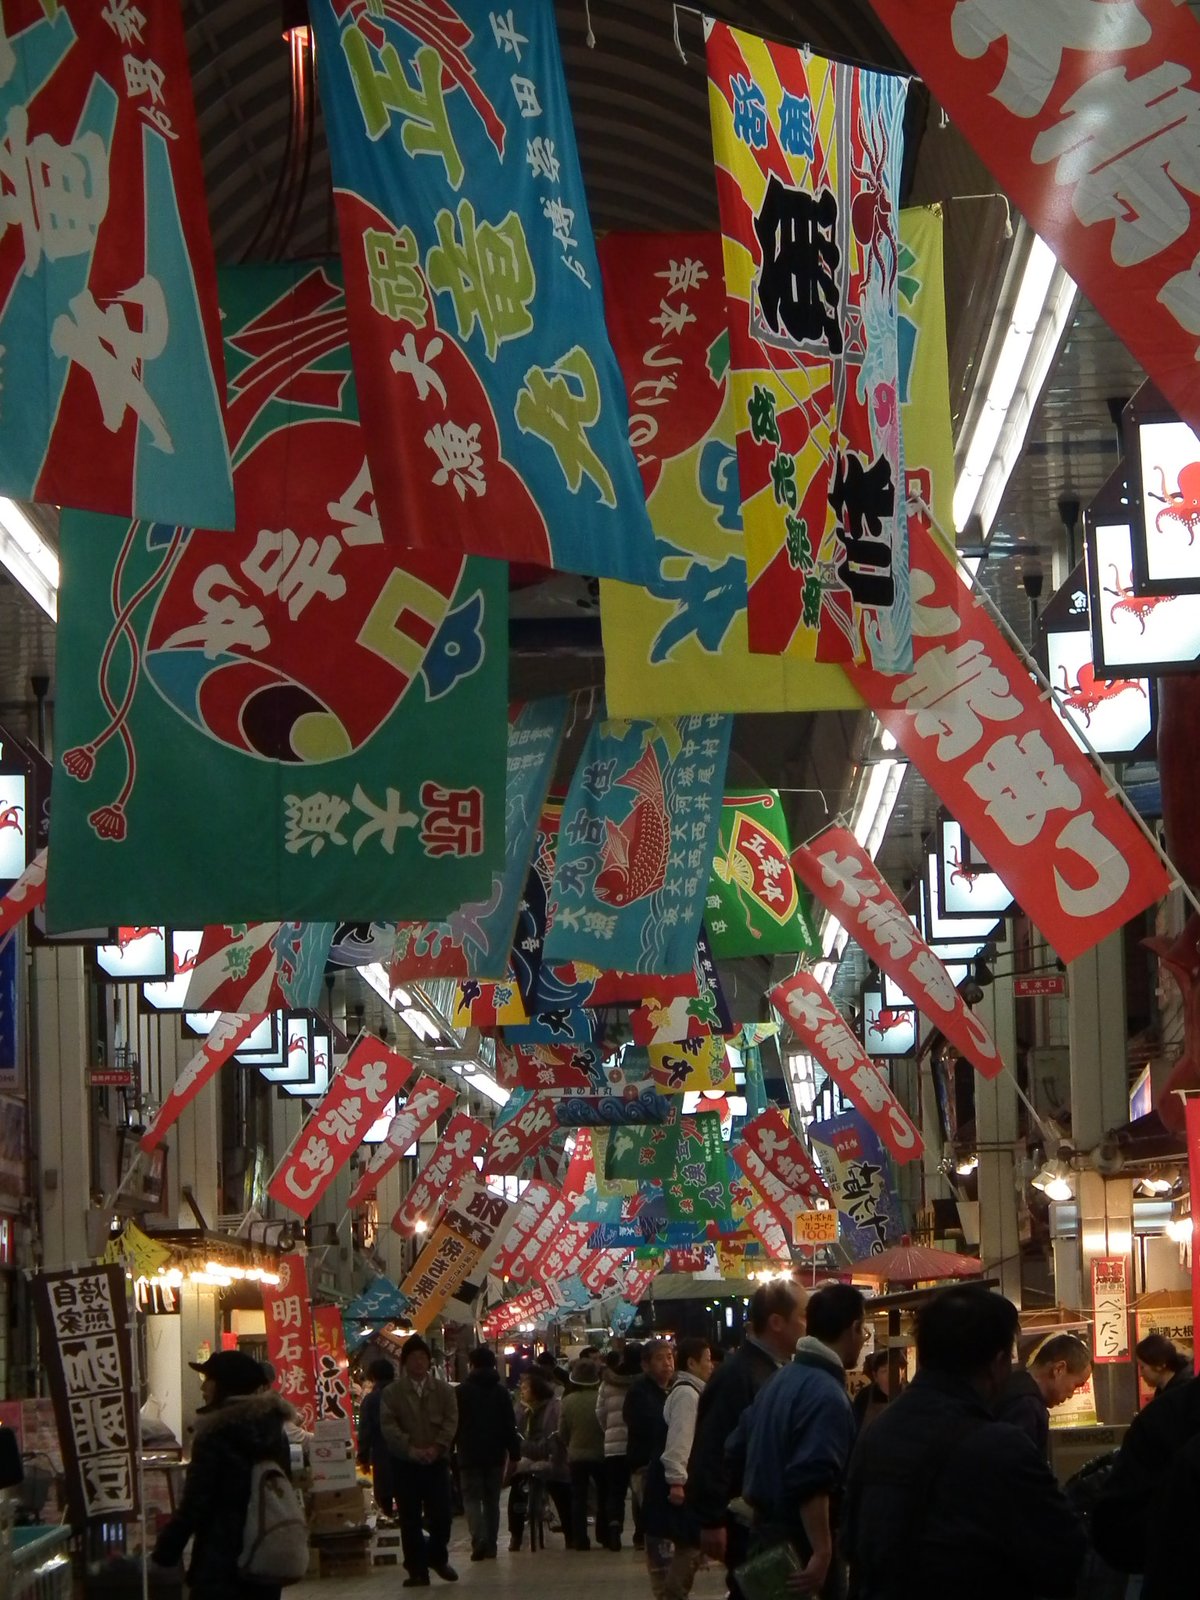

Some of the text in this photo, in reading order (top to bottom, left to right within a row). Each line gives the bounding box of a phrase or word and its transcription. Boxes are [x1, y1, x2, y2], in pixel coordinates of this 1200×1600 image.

[284, 1060, 388, 1200] 大売出し
[271, 1294, 310, 1395] 明石焼
[1097, 1298, 1122, 1355] べったら
